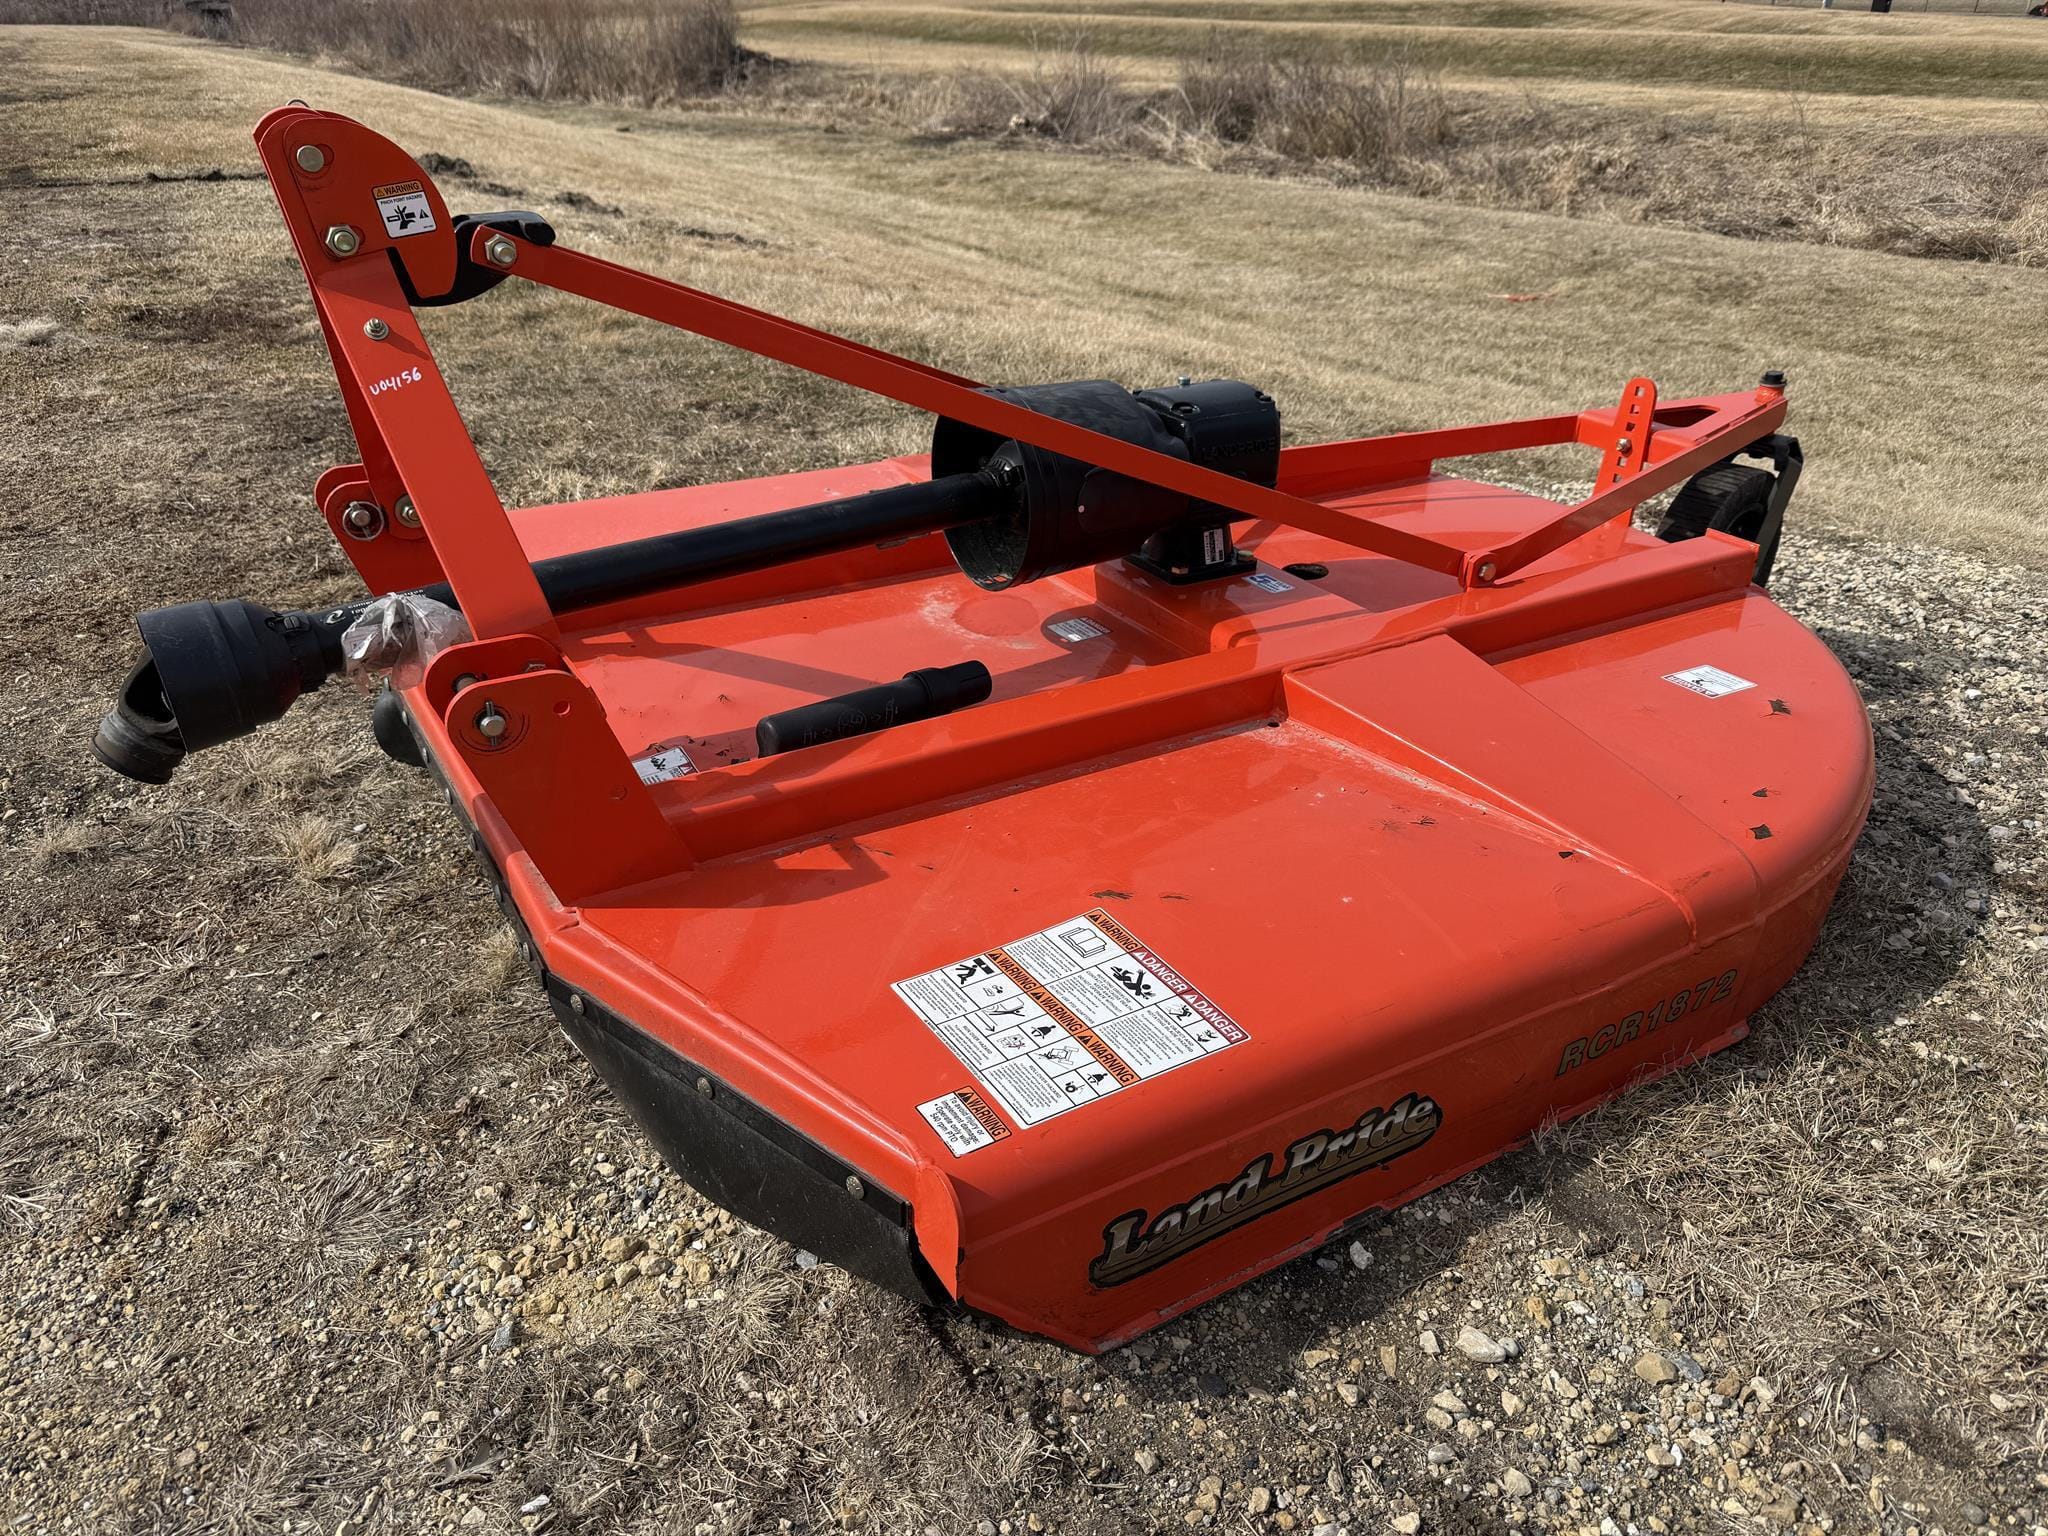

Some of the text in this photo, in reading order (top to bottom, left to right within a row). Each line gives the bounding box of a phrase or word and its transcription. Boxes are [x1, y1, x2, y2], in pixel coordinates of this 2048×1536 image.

[383, 182, 420, 195] WARNING
[369, 366, 422, 395] U04156
[1095, 917, 1139, 950] WARNING
[995, 956, 1037, 990] WARNING
[1140, 956, 1189, 993] DANGER
[1038, 996, 1083, 1033] WARNING
[1190, 1000, 1244, 1041] DANGER
[1555, 968, 1738, 1077] RCR1872
[1085, 1041, 1136, 1083] WARNING
[928, 1112, 941, 1122] 540
[935, 1120, 949, 1132] rpm
[944, 1130, 959, 1143] PTO
[934, 1105, 955, 1125] Operate
[948, 1123, 963, 1135] only
[957, 1133, 972, 1146] with
[939, 1099, 965, 1124] implement
[957, 1122, 982, 1145] damage:
[948, 1096, 985, 1136] To avoid injury or
[965, 1097, 1007, 1137] WARNING
[1101, 1093, 1441, 1270] Land Pride
